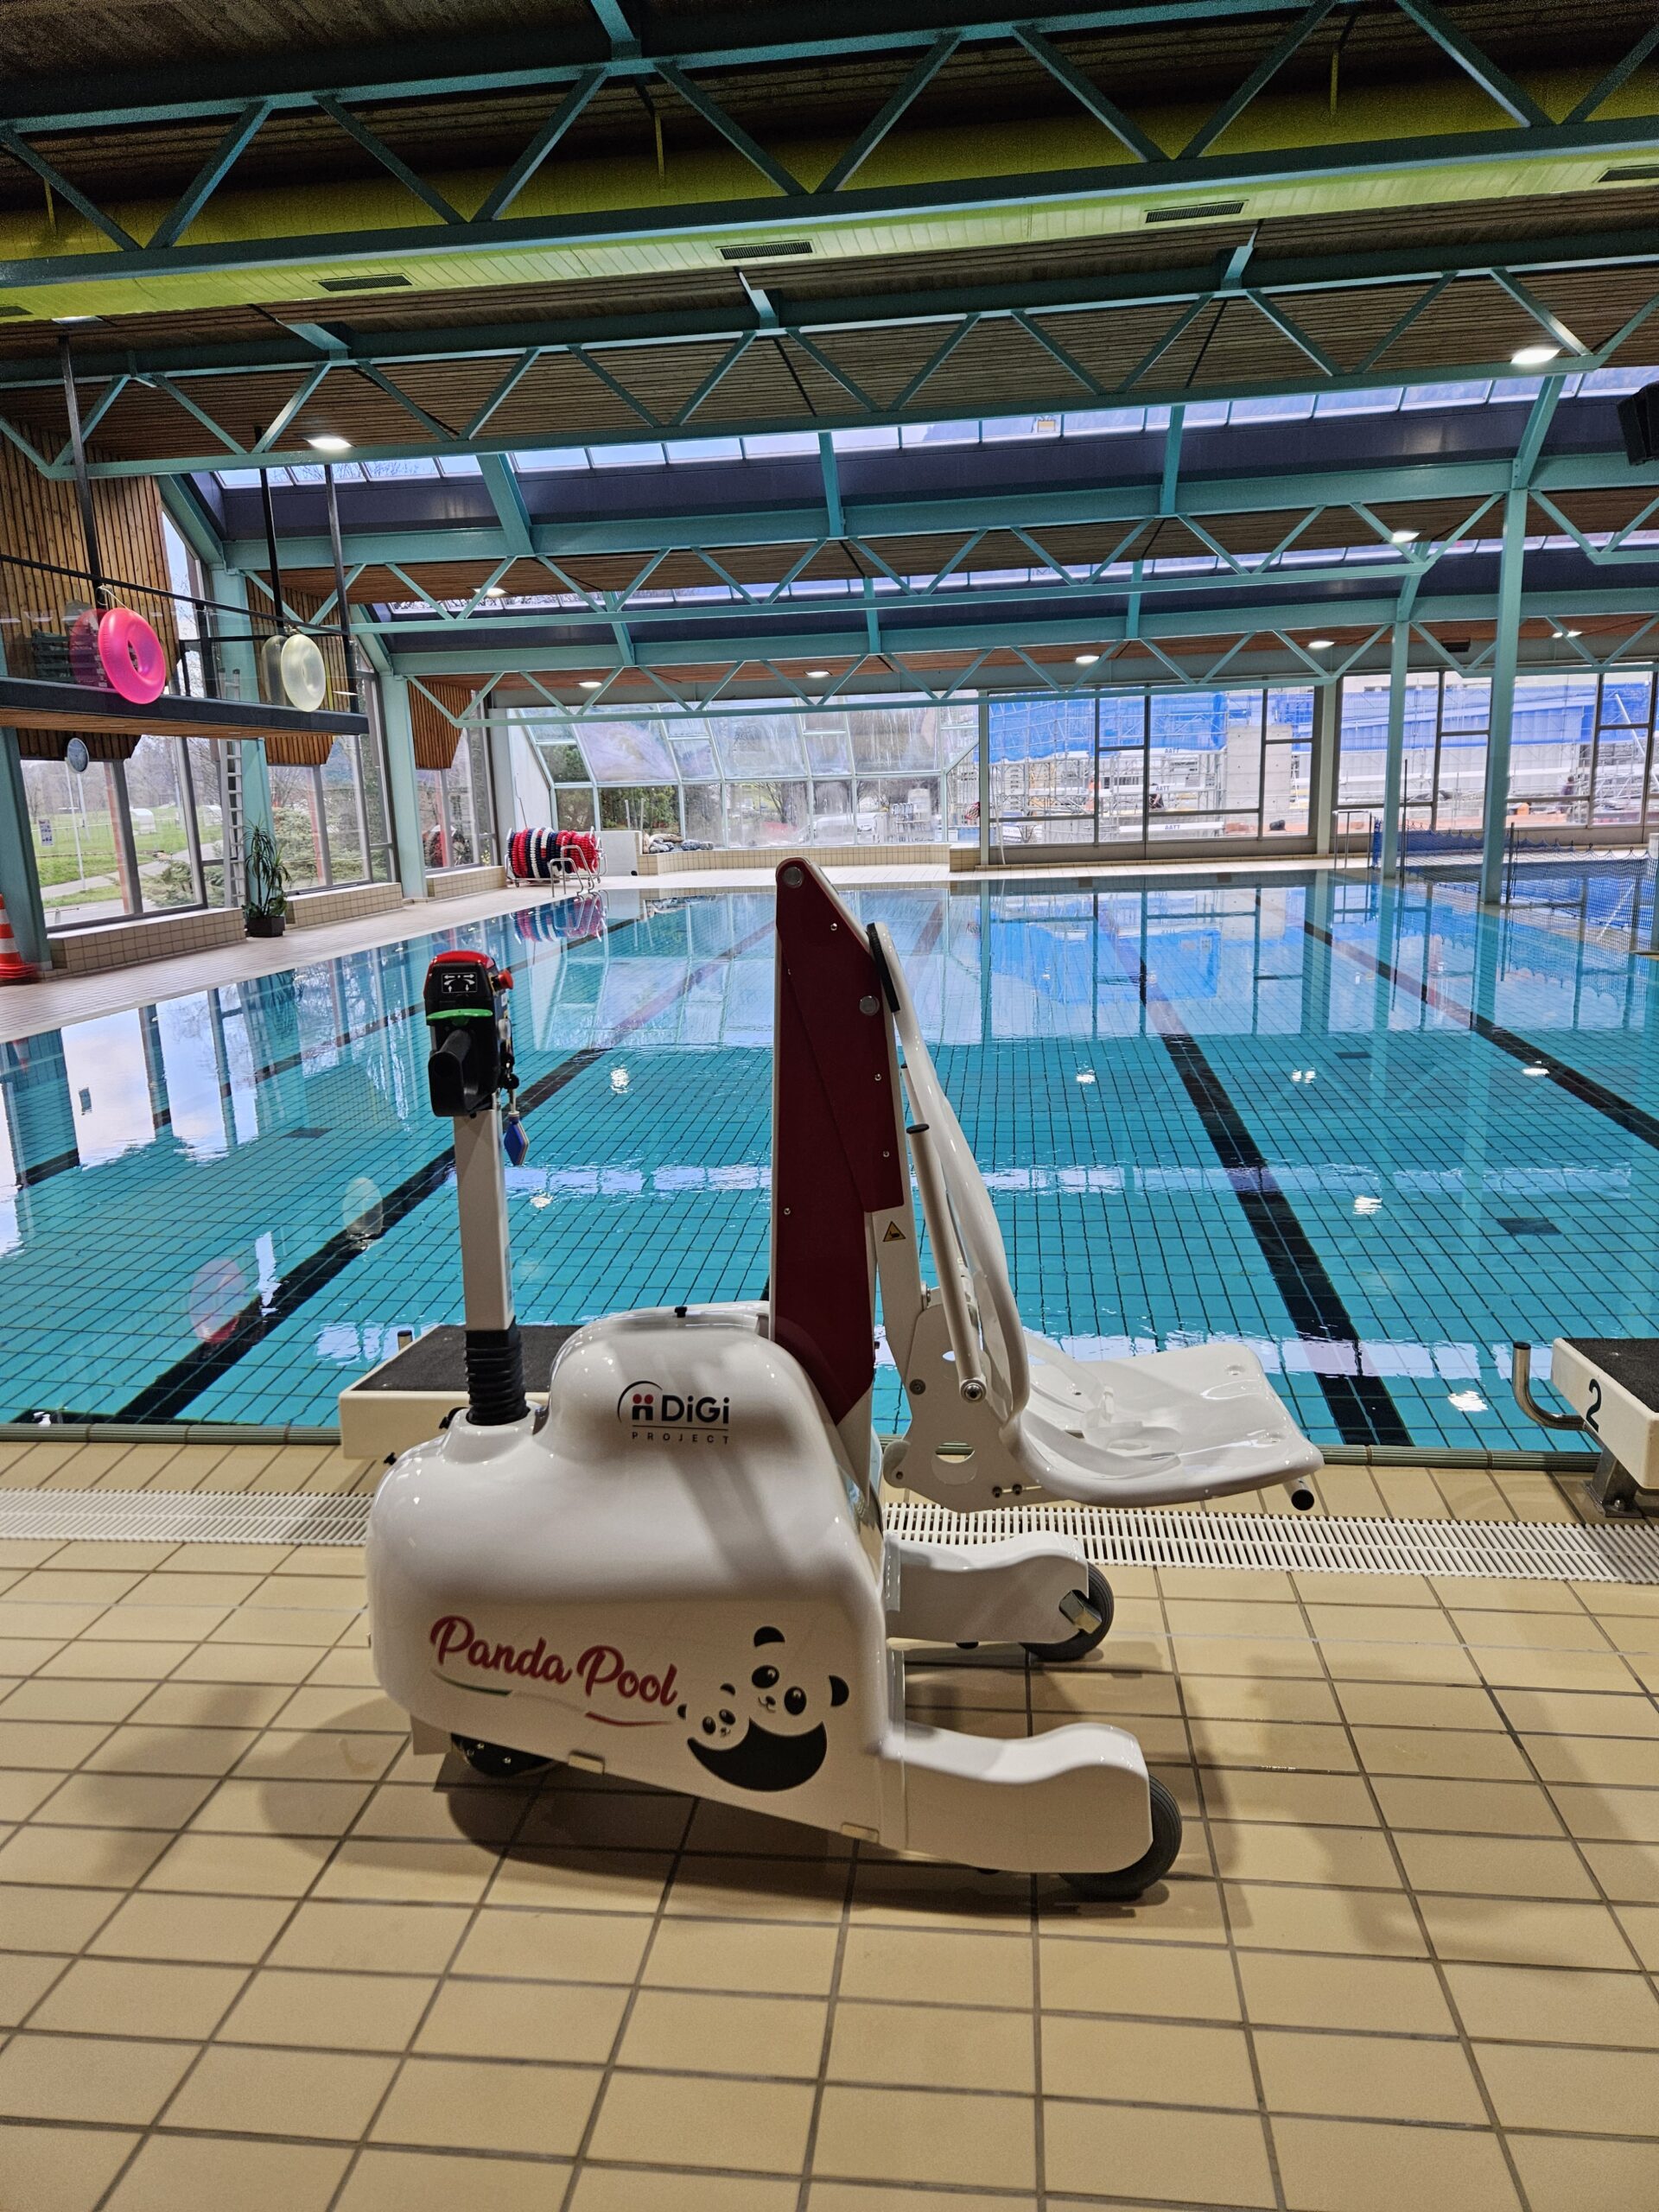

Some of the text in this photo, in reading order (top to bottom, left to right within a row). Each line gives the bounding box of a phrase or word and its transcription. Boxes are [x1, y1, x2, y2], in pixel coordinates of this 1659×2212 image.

[661, 1395, 729, 1424] DiGi
[1586, 1378, 1601, 1433] 2
[632, 1431, 728, 1445] PROJECT
[429, 1614, 678, 1707] Panda Pool
